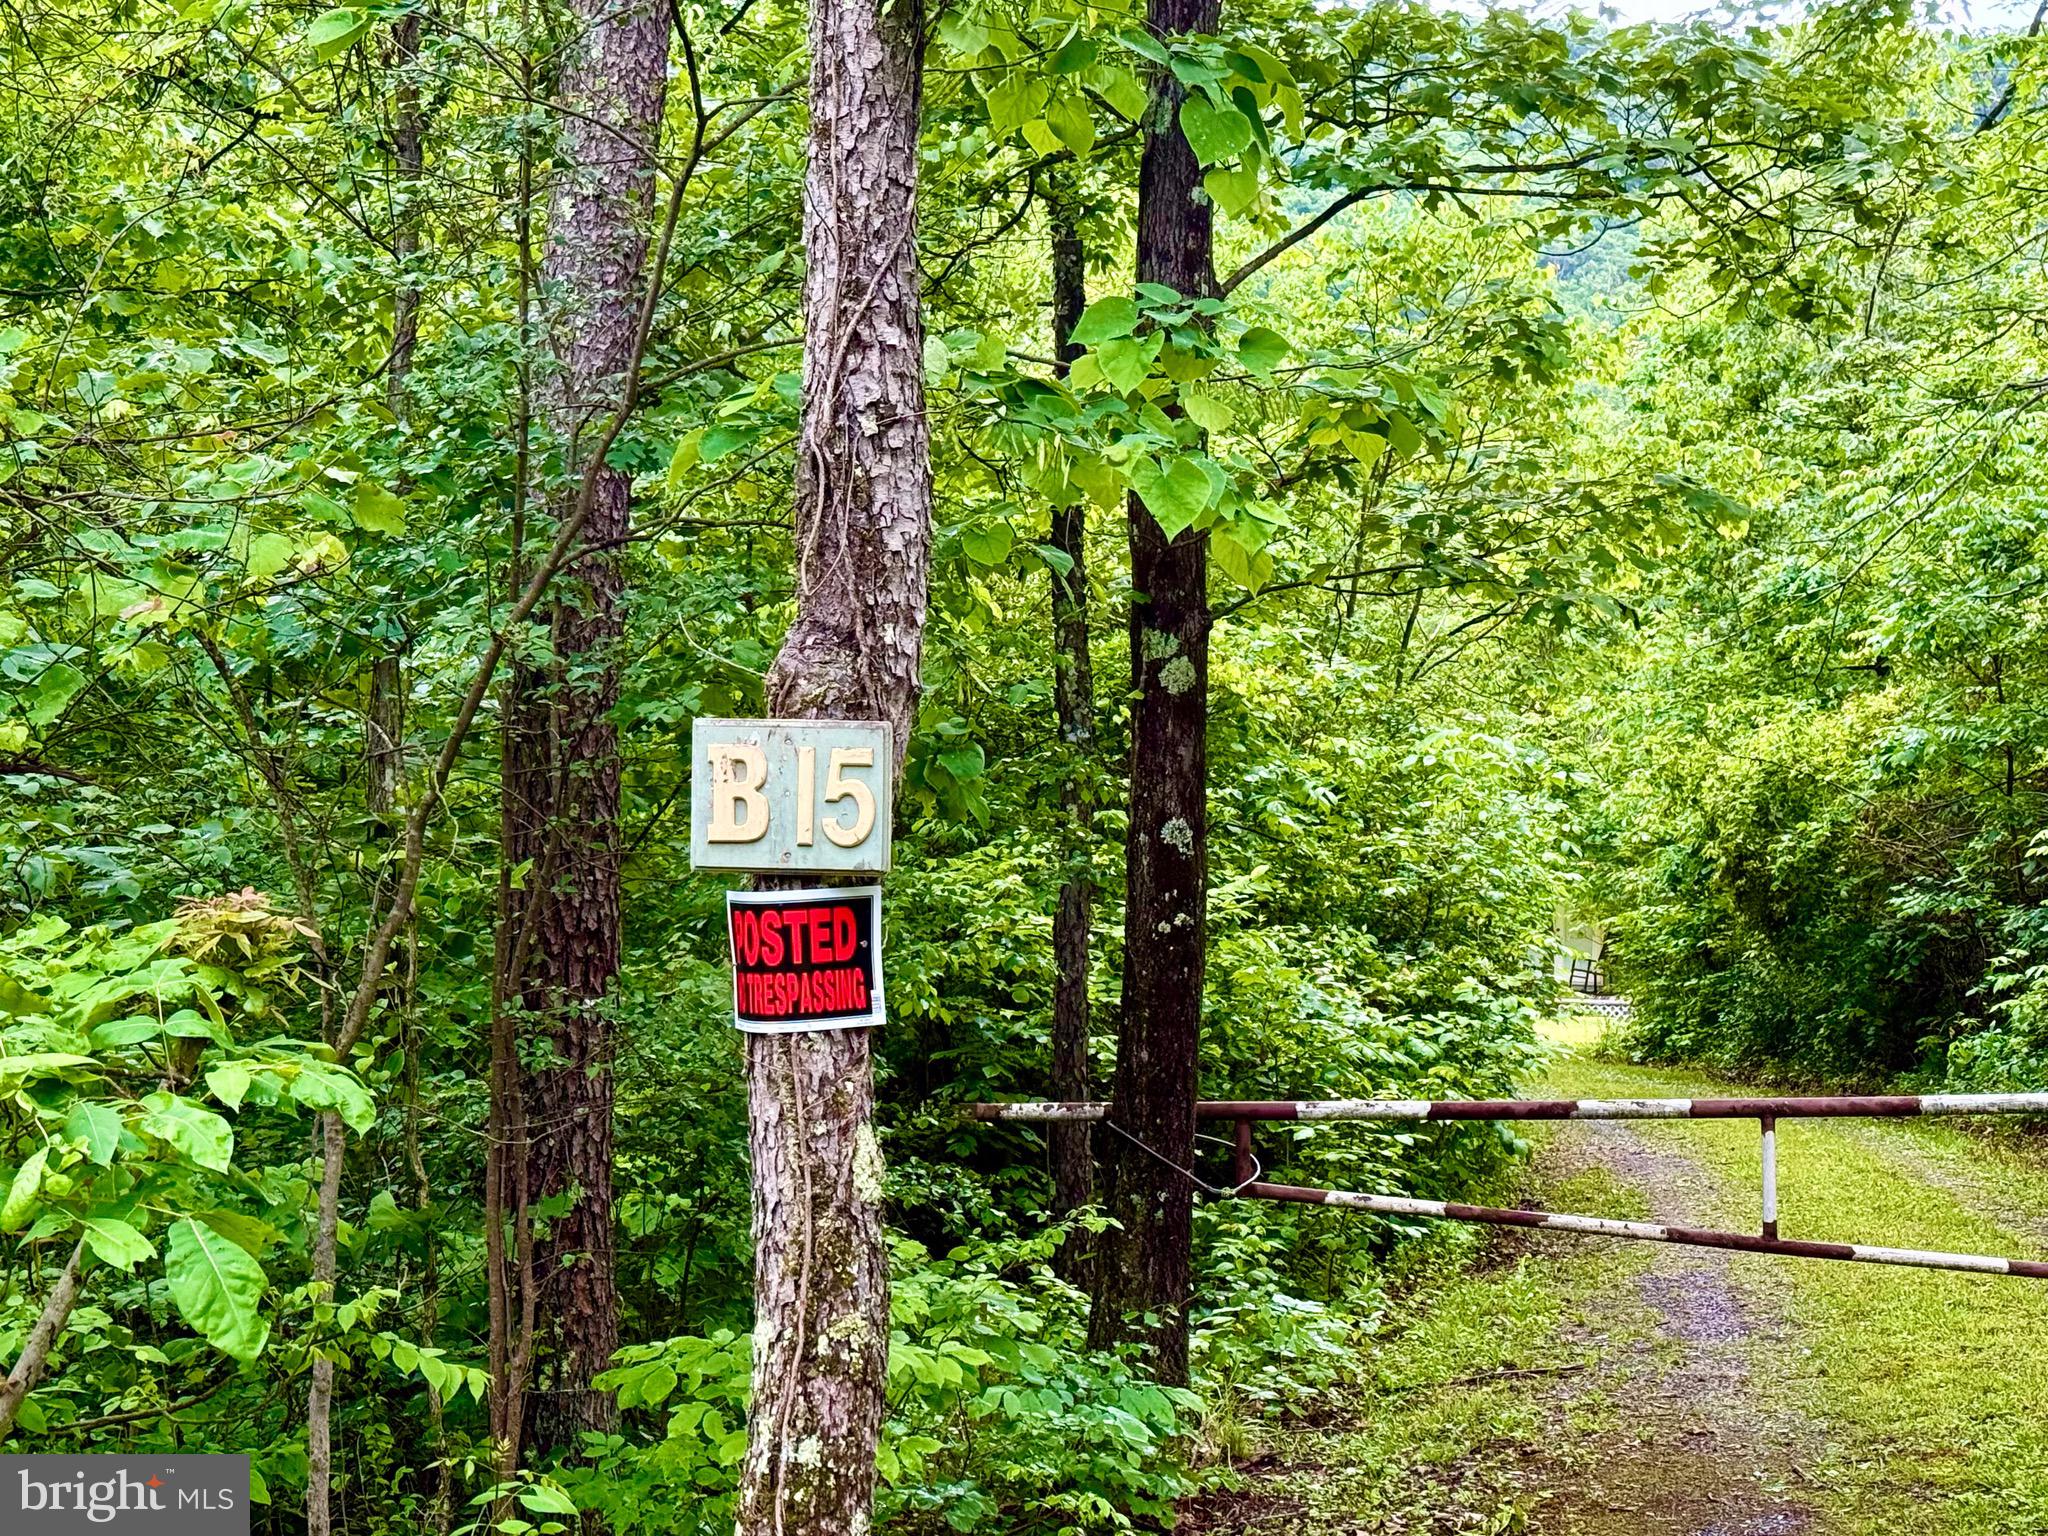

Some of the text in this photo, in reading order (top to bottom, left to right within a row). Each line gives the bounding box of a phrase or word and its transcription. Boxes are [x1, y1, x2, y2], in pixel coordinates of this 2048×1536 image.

[707, 743, 876, 848] B 15
[734, 906, 857, 967] POSTED
[747, 967, 866, 1017] TRESPASSING
